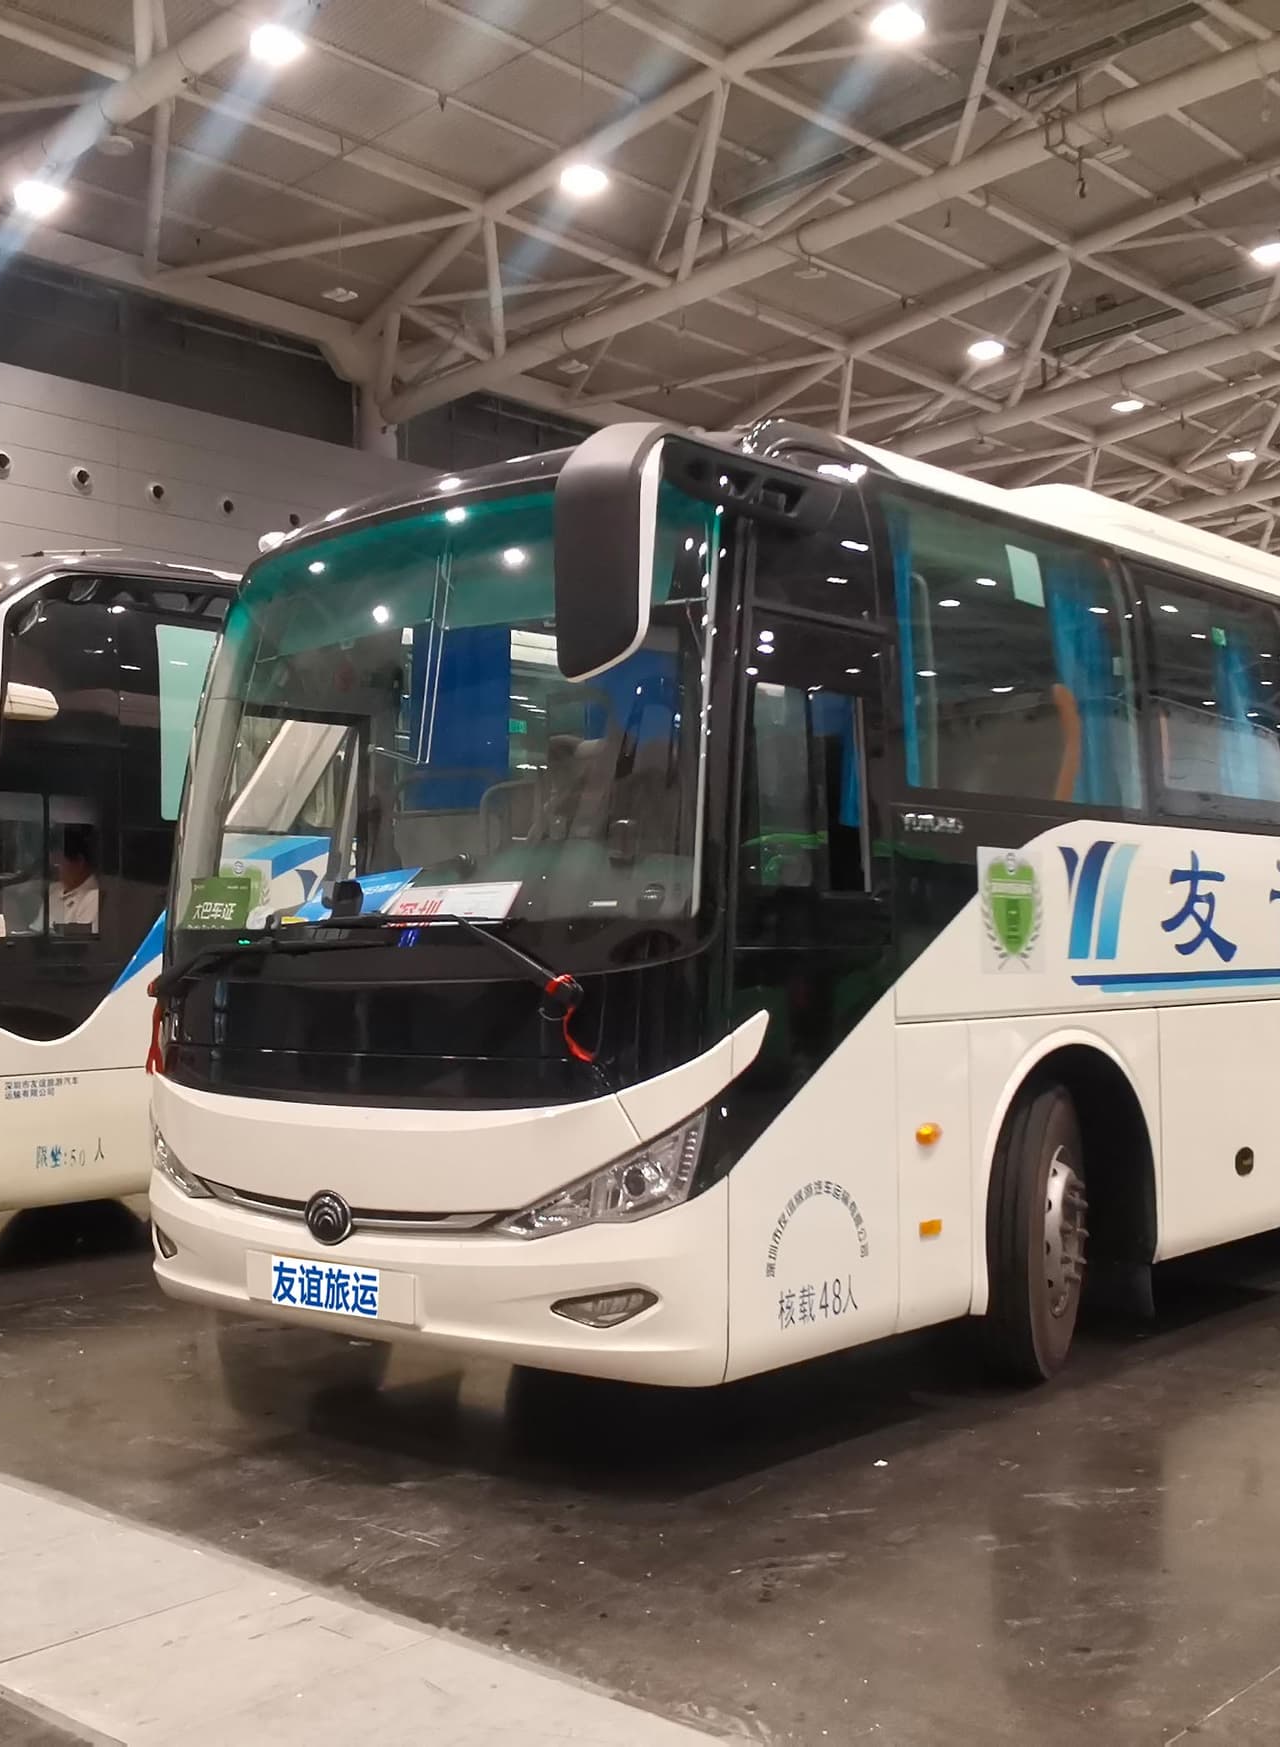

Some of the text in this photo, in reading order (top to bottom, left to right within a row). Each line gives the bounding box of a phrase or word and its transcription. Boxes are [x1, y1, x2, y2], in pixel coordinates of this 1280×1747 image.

[192, 901, 237, 921] 大巴车证
[778, 1274, 858, 1331] 核载48人
